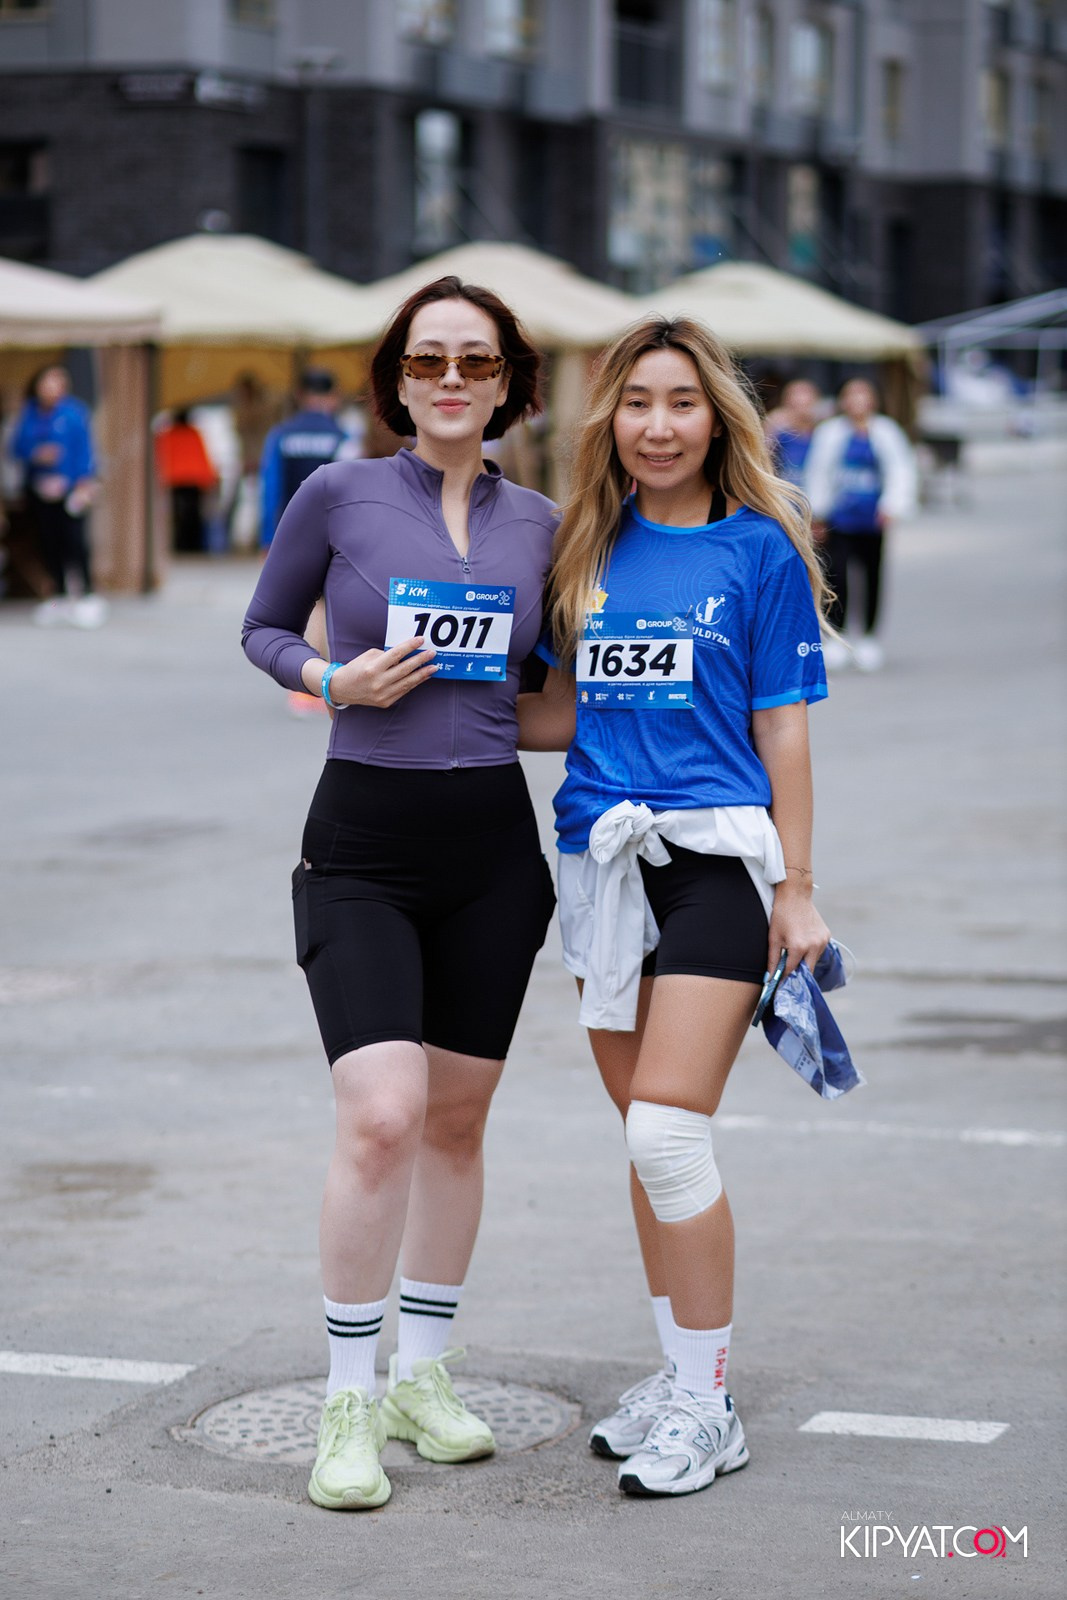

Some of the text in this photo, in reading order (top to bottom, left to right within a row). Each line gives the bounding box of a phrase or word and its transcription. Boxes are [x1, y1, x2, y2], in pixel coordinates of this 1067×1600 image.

[395, 583, 428, 597] 5 KM
[476, 593, 499, 601] GROUP
[414, 612, 494, 649] 1011
[647, 620, 673, 628] GROUP
[588, 643, 678, 678] 1634
